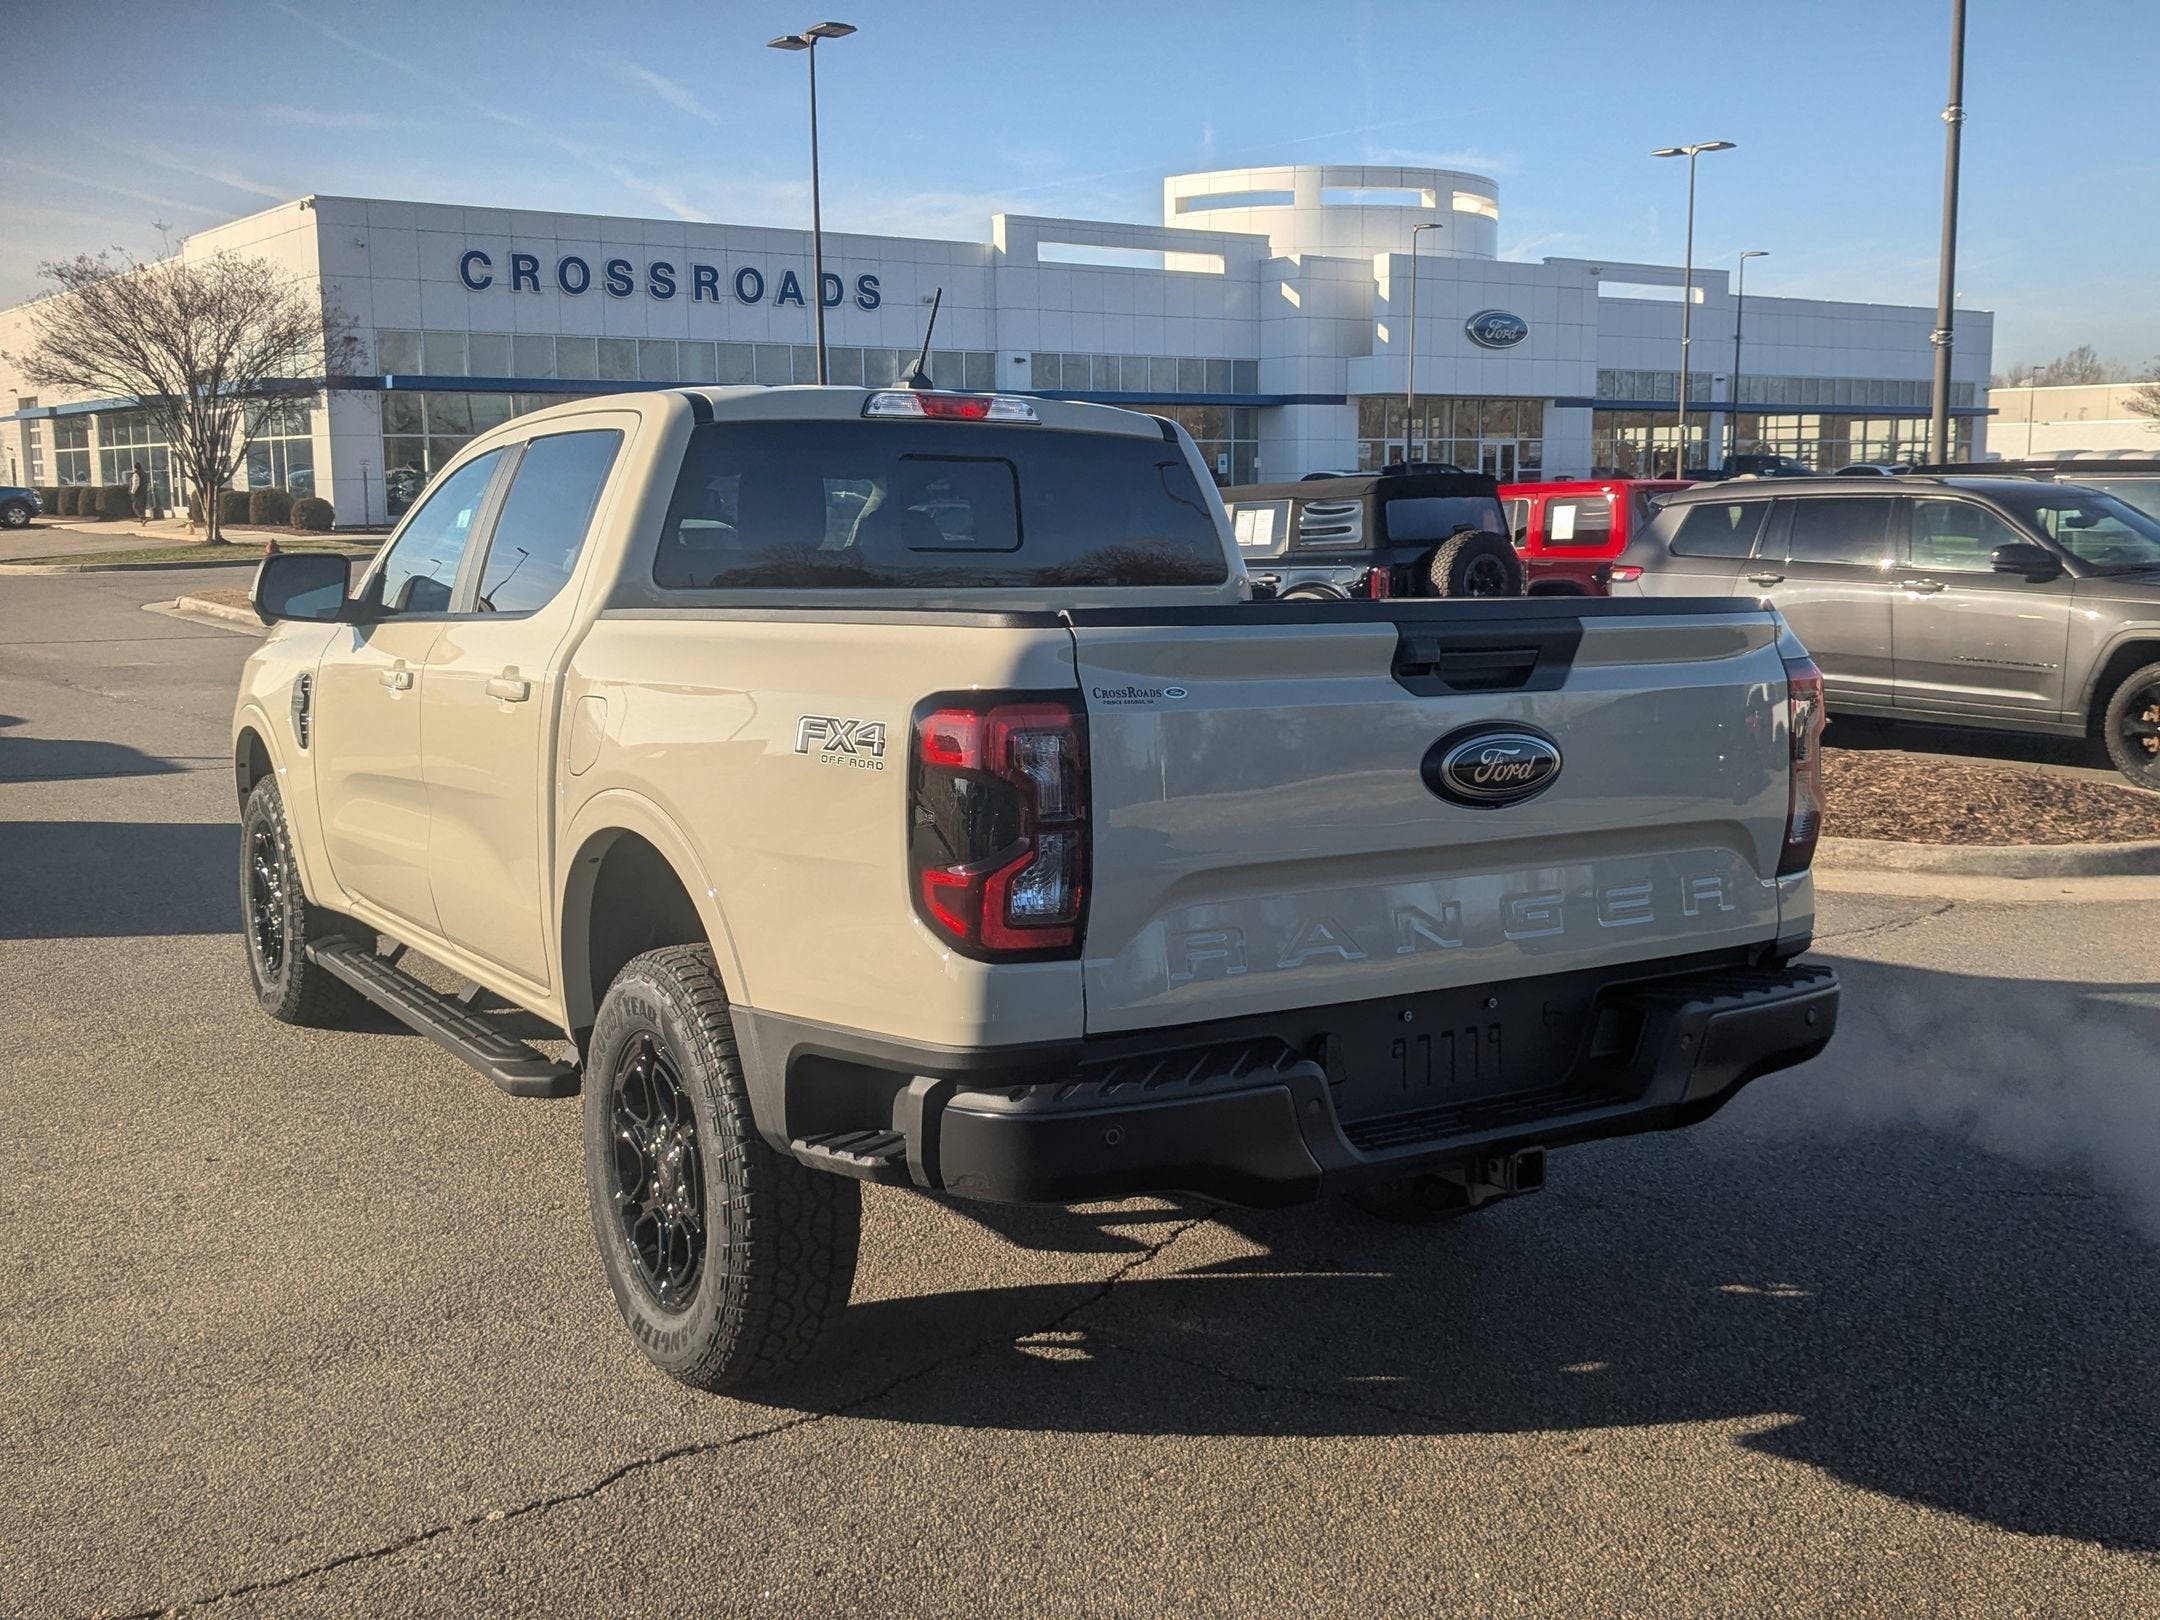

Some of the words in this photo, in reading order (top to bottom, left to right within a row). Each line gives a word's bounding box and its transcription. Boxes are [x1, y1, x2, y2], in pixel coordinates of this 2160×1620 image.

[459, 249, 881, 311] CROSSROADS
[794, 714, 887, 757] FX4
[821, 754, 845, 765] OFF
[849, 757, 884, 771] ROAD
[1474, 748, 1536, 783] Ford
[1169, 875, 1737, 980] RANGER
